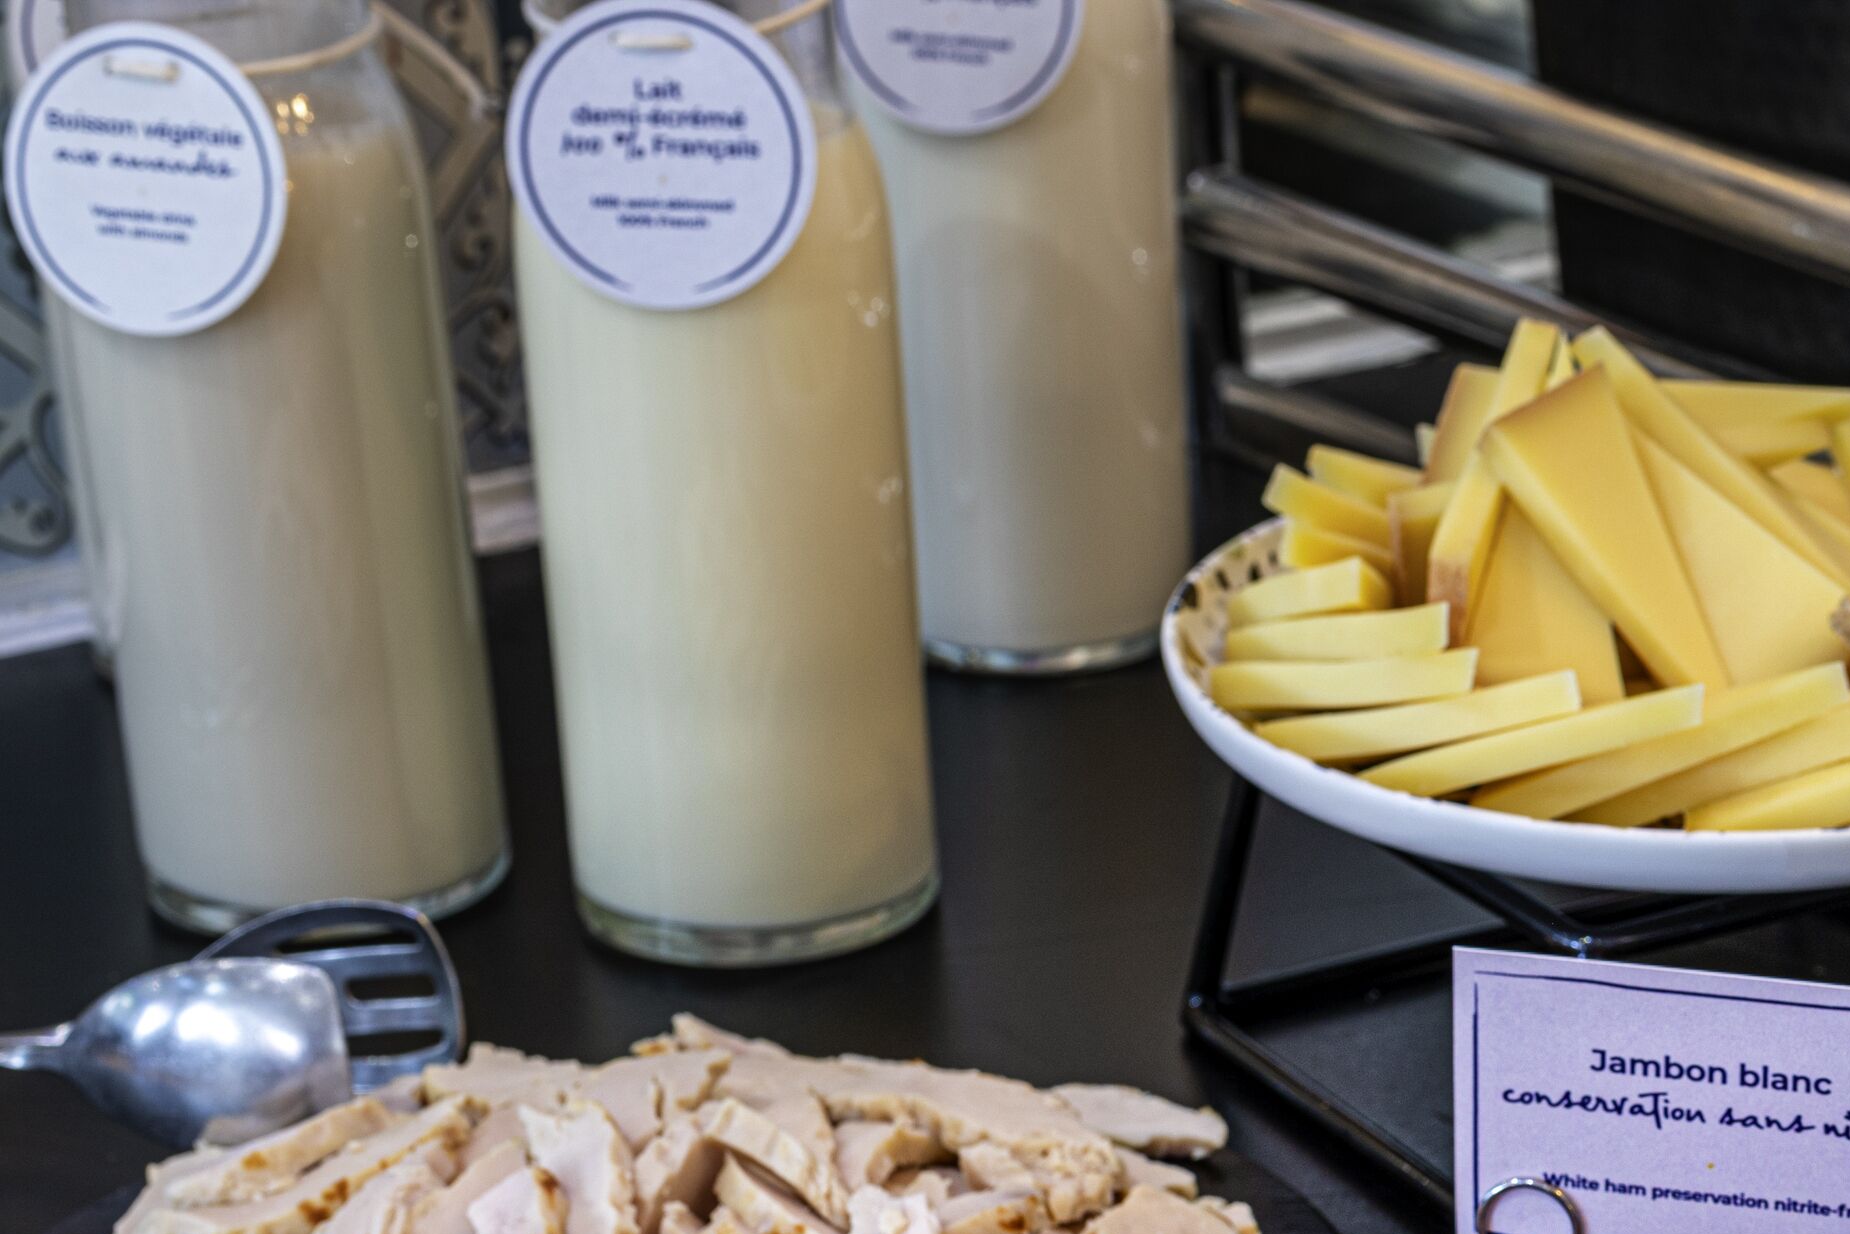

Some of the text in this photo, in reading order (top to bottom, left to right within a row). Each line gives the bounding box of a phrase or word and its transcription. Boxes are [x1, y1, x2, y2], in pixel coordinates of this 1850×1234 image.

[634, 80, 681, 99] Lait
[46, 108, 134, 134] Boisson
[1589, 1048, 1833, 1096] Jambon blanc
[1502, 1086, 1706, 1129] conservation
[1719, 1105, 1814, 1134] sans
[1543, 1172, 1600, 1191] White
[1604, 1178, 1647, 1197] ham
[1651, 1184, 1770, 1213] preservation
